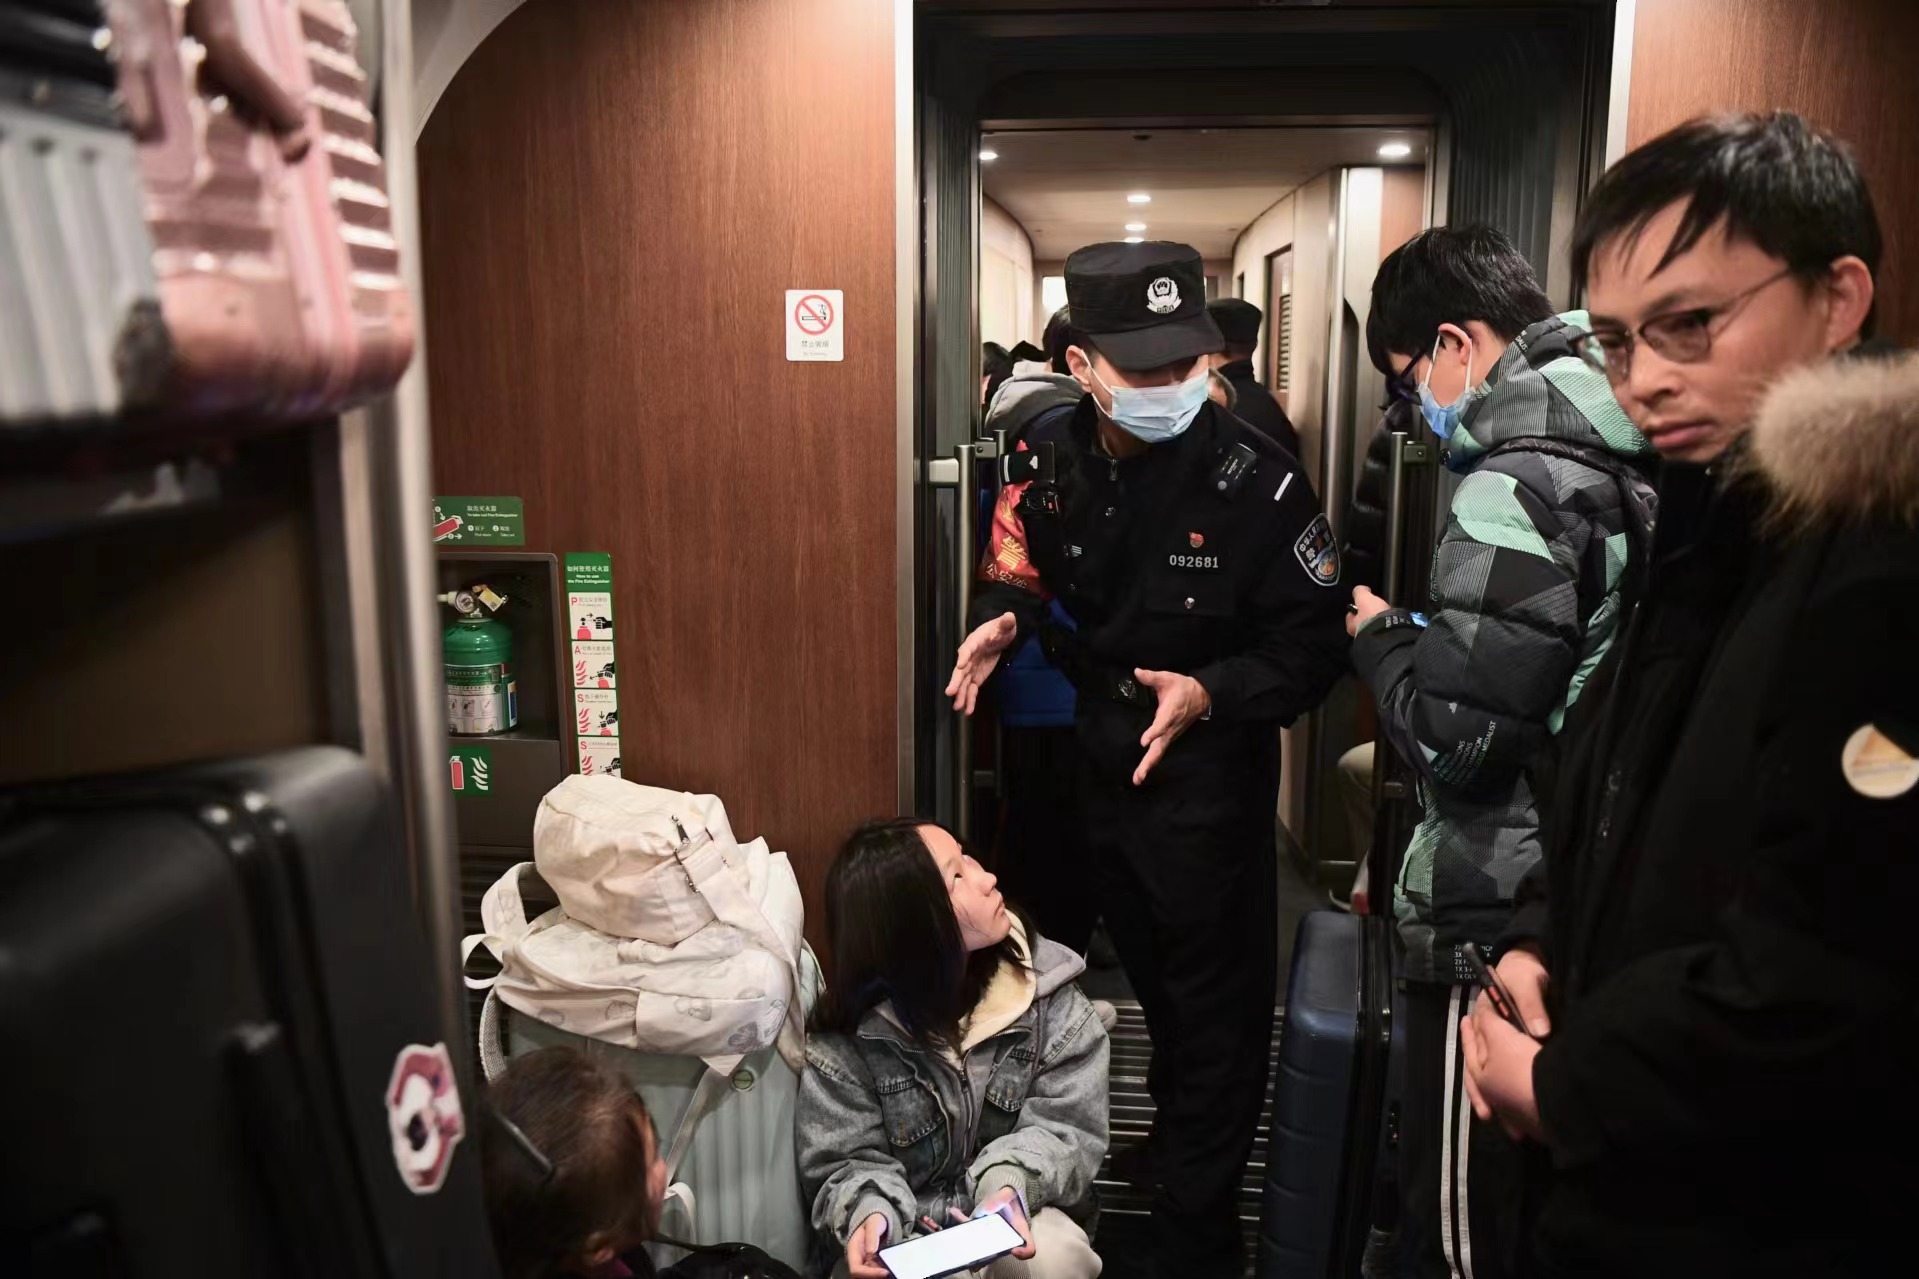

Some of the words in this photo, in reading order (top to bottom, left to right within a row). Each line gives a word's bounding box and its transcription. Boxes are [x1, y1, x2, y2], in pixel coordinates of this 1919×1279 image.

[1169, 555, 1219, 568] 092681
[571, 597, 578, 606] P
[574, 645, 582, 655] A
[577, 693, 585, 703] S
[1481, 720, 1497, 752] MEDALIST
[580, 740, 588, 750] S
